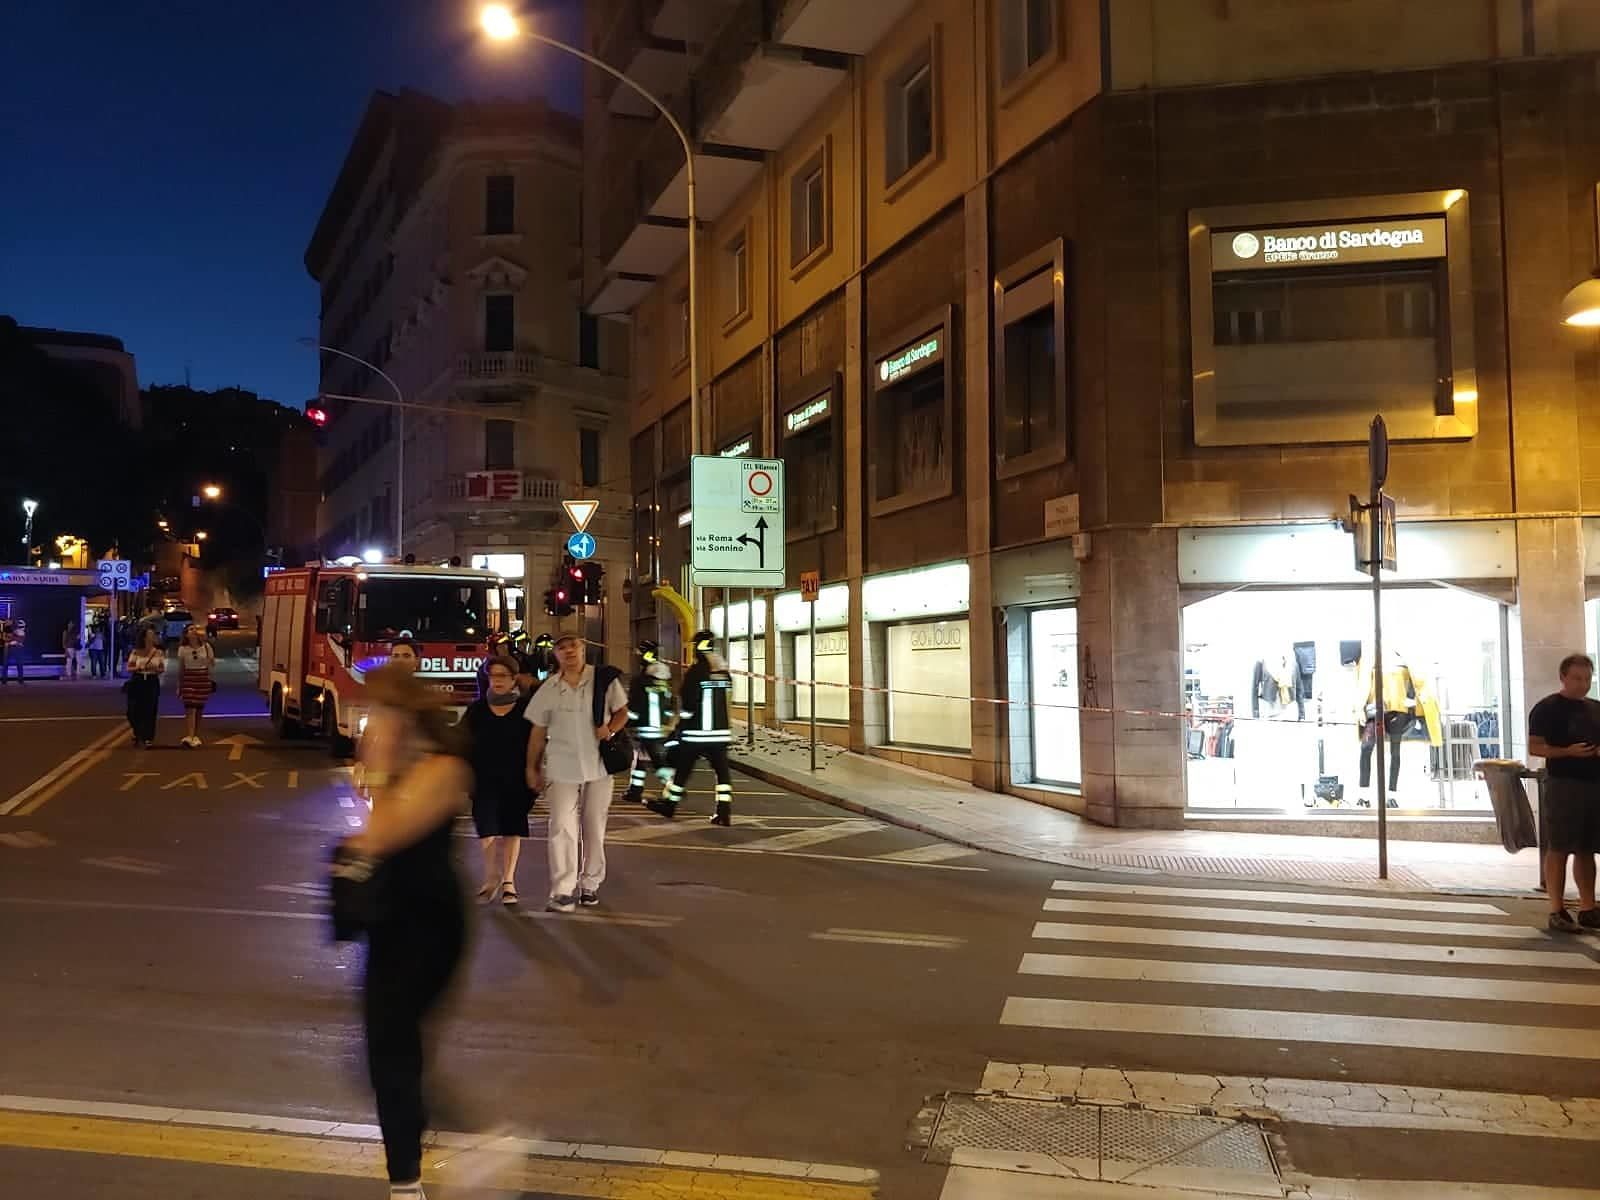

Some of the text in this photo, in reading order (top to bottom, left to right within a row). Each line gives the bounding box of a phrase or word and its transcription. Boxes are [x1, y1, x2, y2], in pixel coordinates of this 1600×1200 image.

[1264, 228, 1424, 252] Banco di Sardegna
[708, 534, 733, 542] Roma
[708, 544, 744, 552] Sonnino
[801, 579, 818, 593] TAXI
[420, 657, 482, 671] DEL FUO
[119, 771, 299, 791] TAXI
